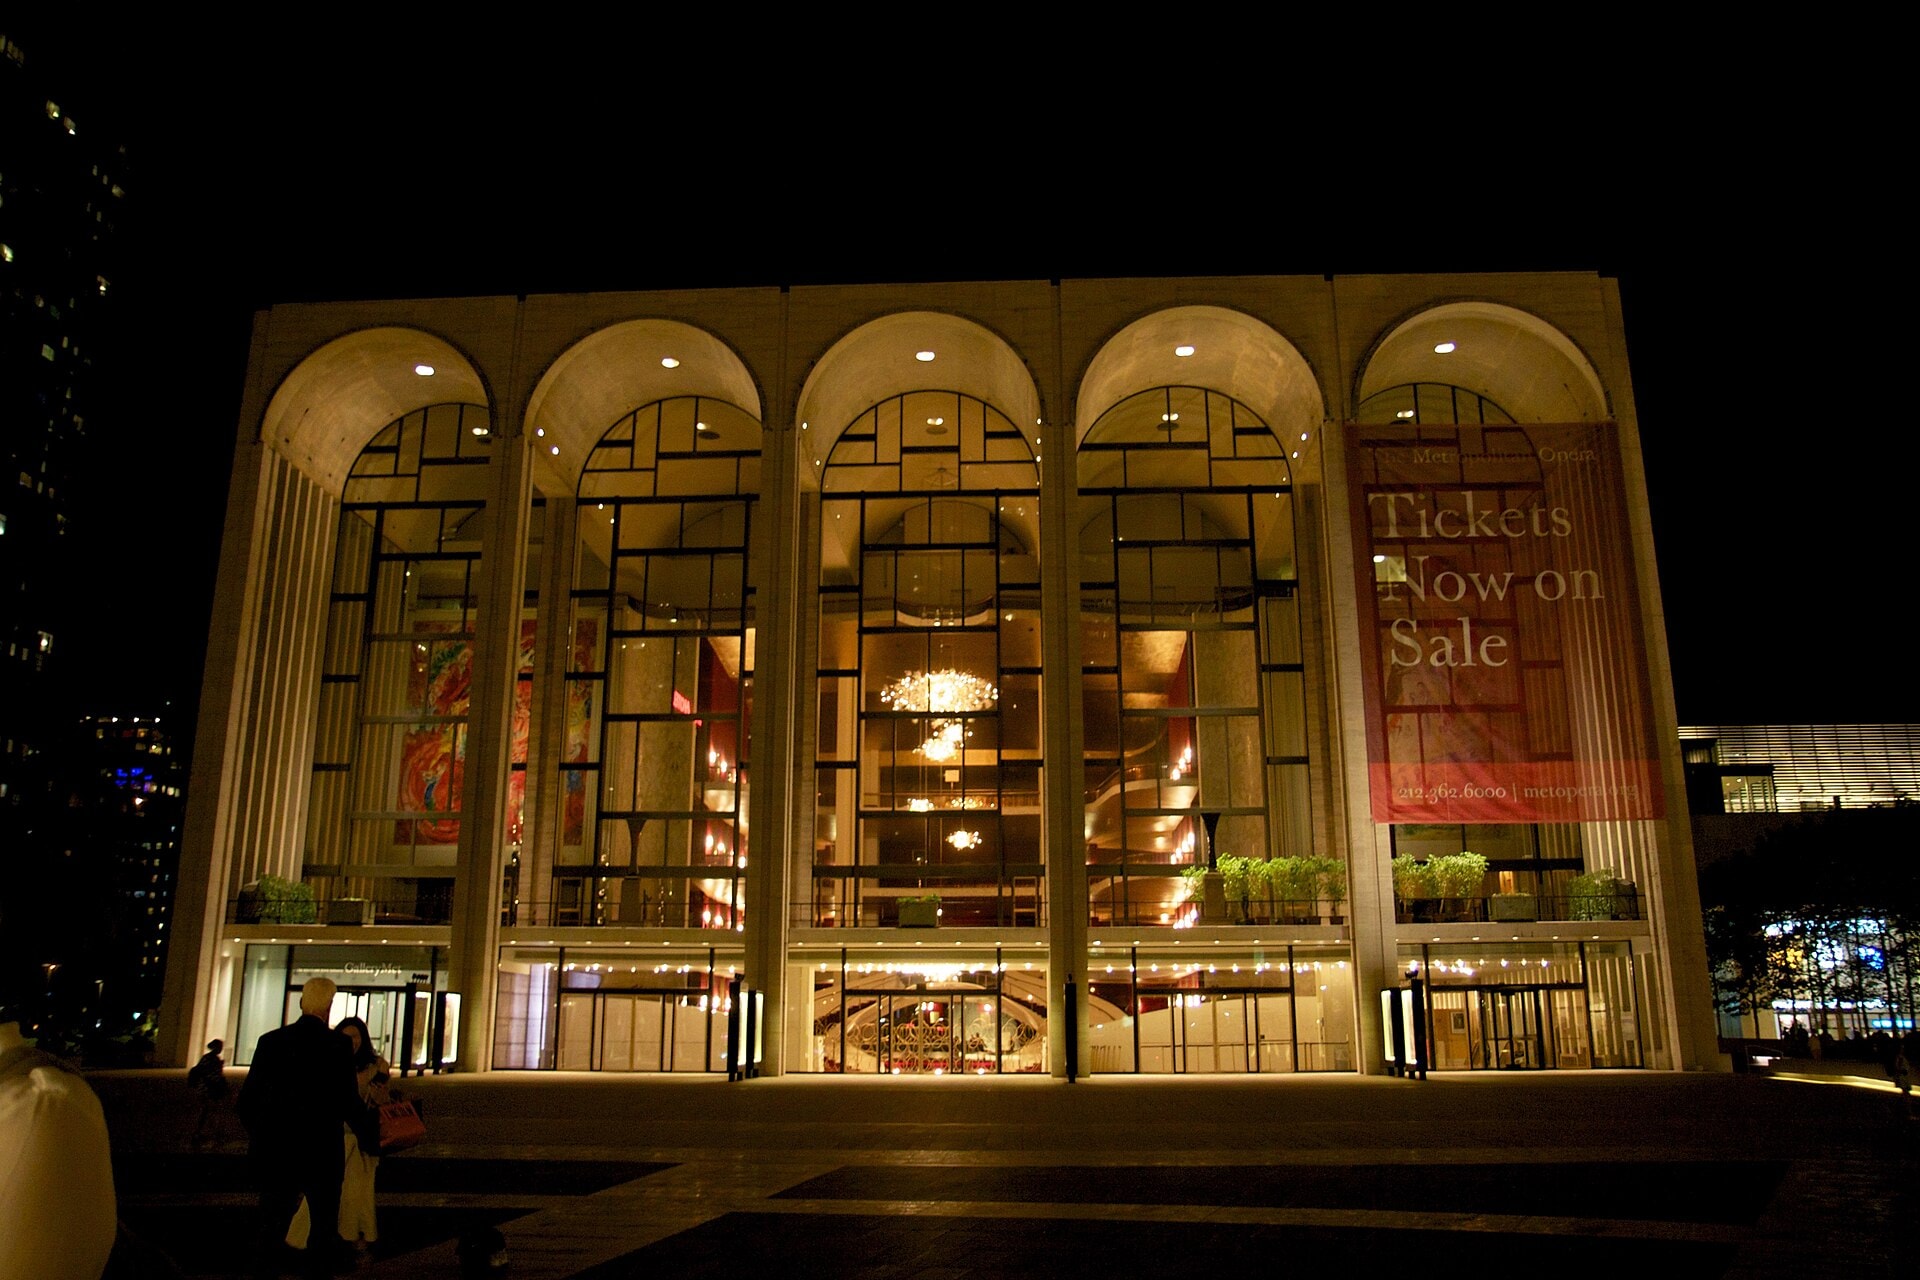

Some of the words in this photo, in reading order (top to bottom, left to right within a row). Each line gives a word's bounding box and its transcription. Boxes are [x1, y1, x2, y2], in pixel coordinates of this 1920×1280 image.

[1539, 446, 1595, 466] Opera
[1368, 490, 1572, 540] Tickets
[1380, 555, 1515, 603] Now
[1534, 567, 1605, 601] on
[1390, 617, 1508, 667] Sale
[1399, 783, 1506, 804] 212.362.6000
